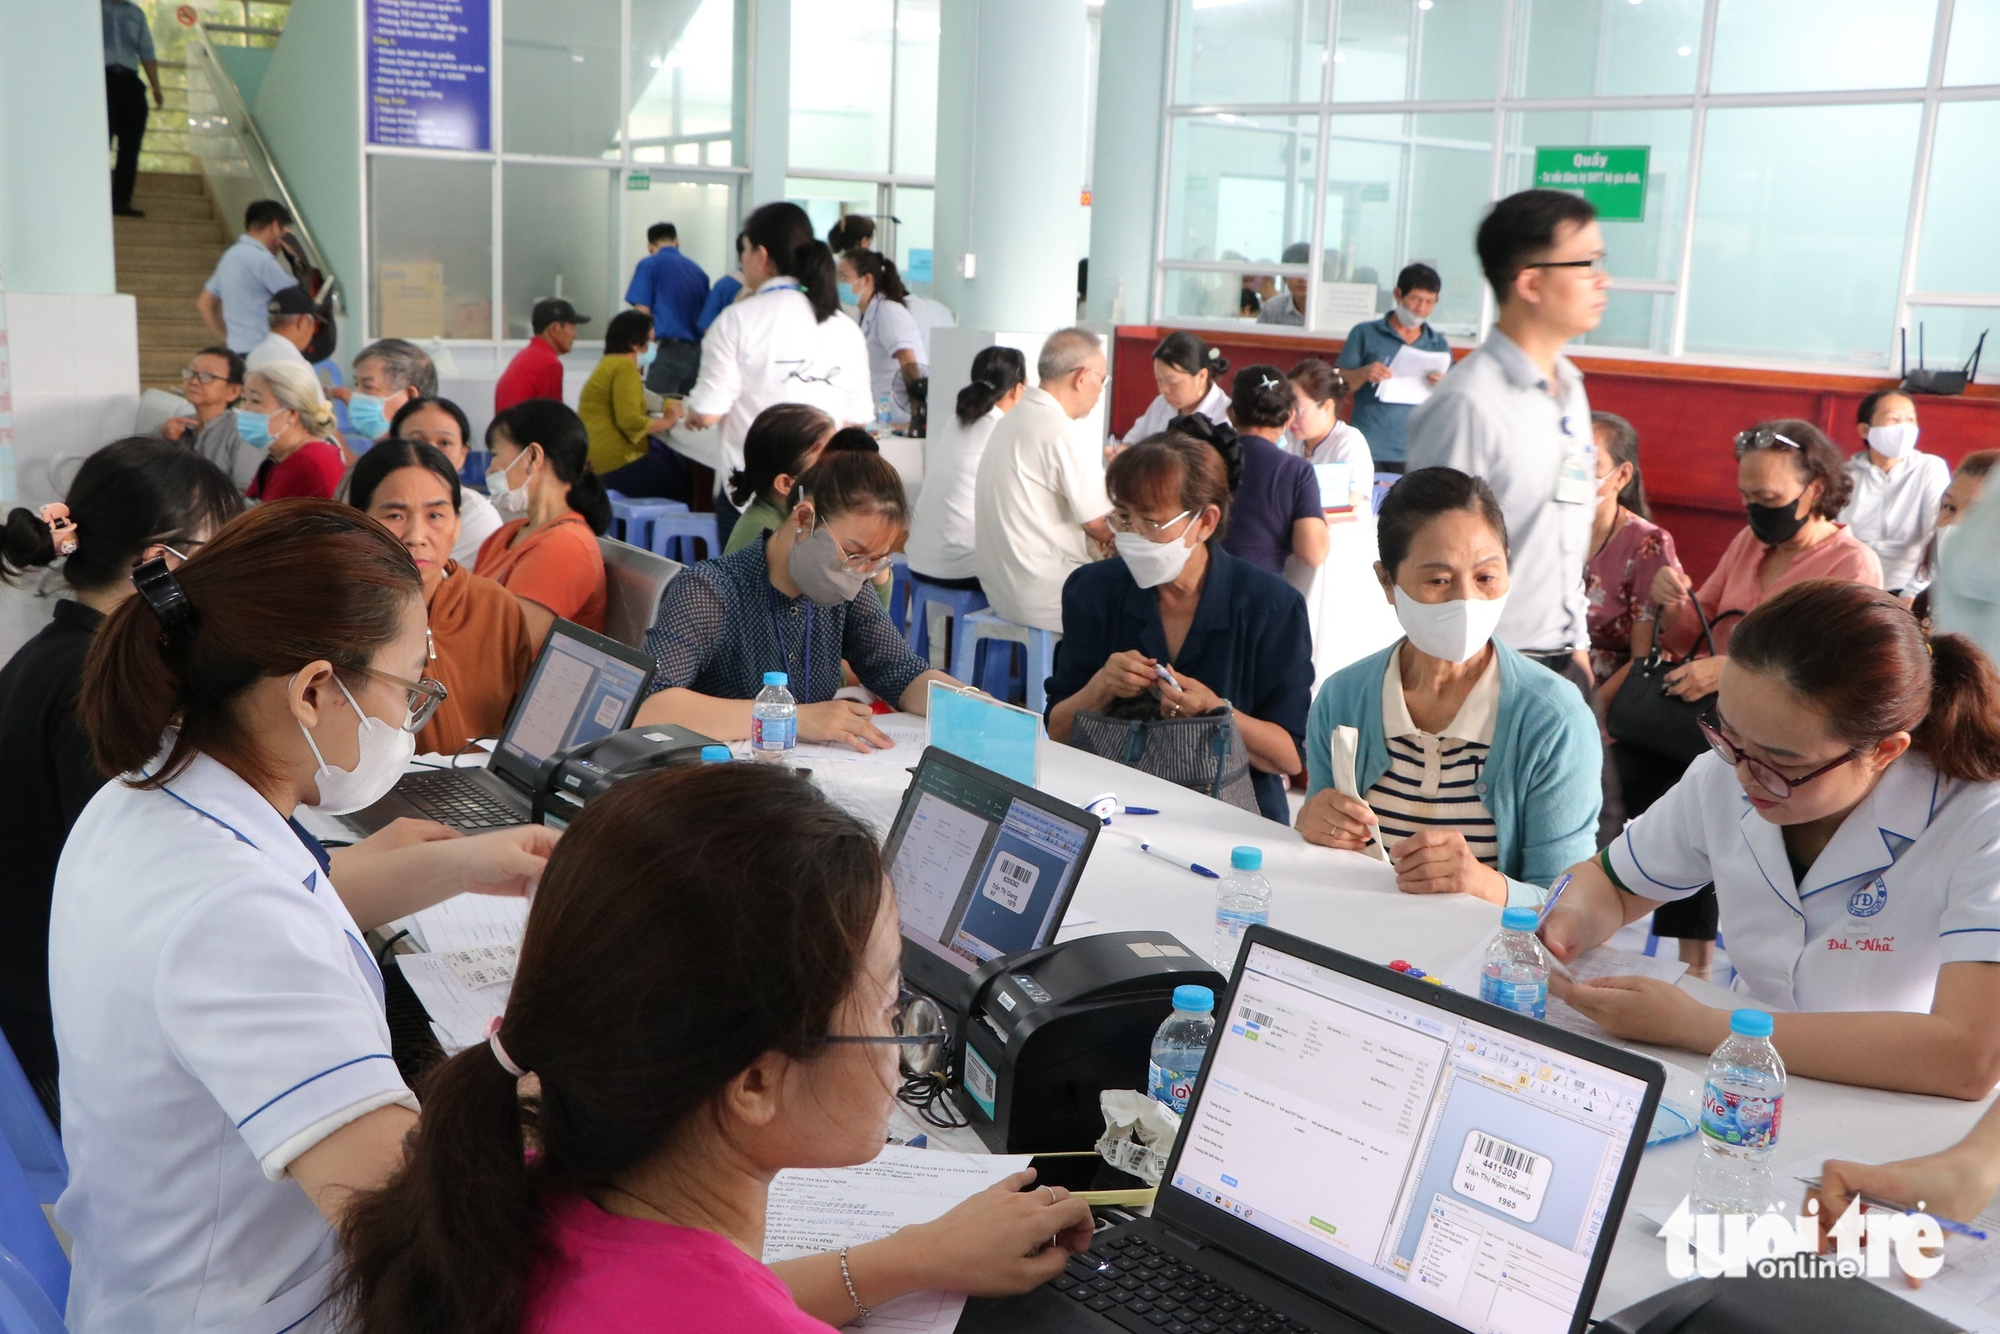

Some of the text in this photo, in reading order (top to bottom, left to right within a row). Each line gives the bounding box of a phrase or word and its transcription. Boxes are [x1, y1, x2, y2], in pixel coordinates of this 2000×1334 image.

[1482, 1159, 1518, 1180] 4411305
[1465, 1166, 1531, 1200] Trần Thị Ngọc Hương
[1498, 1196, 1517, 1209] 1965
